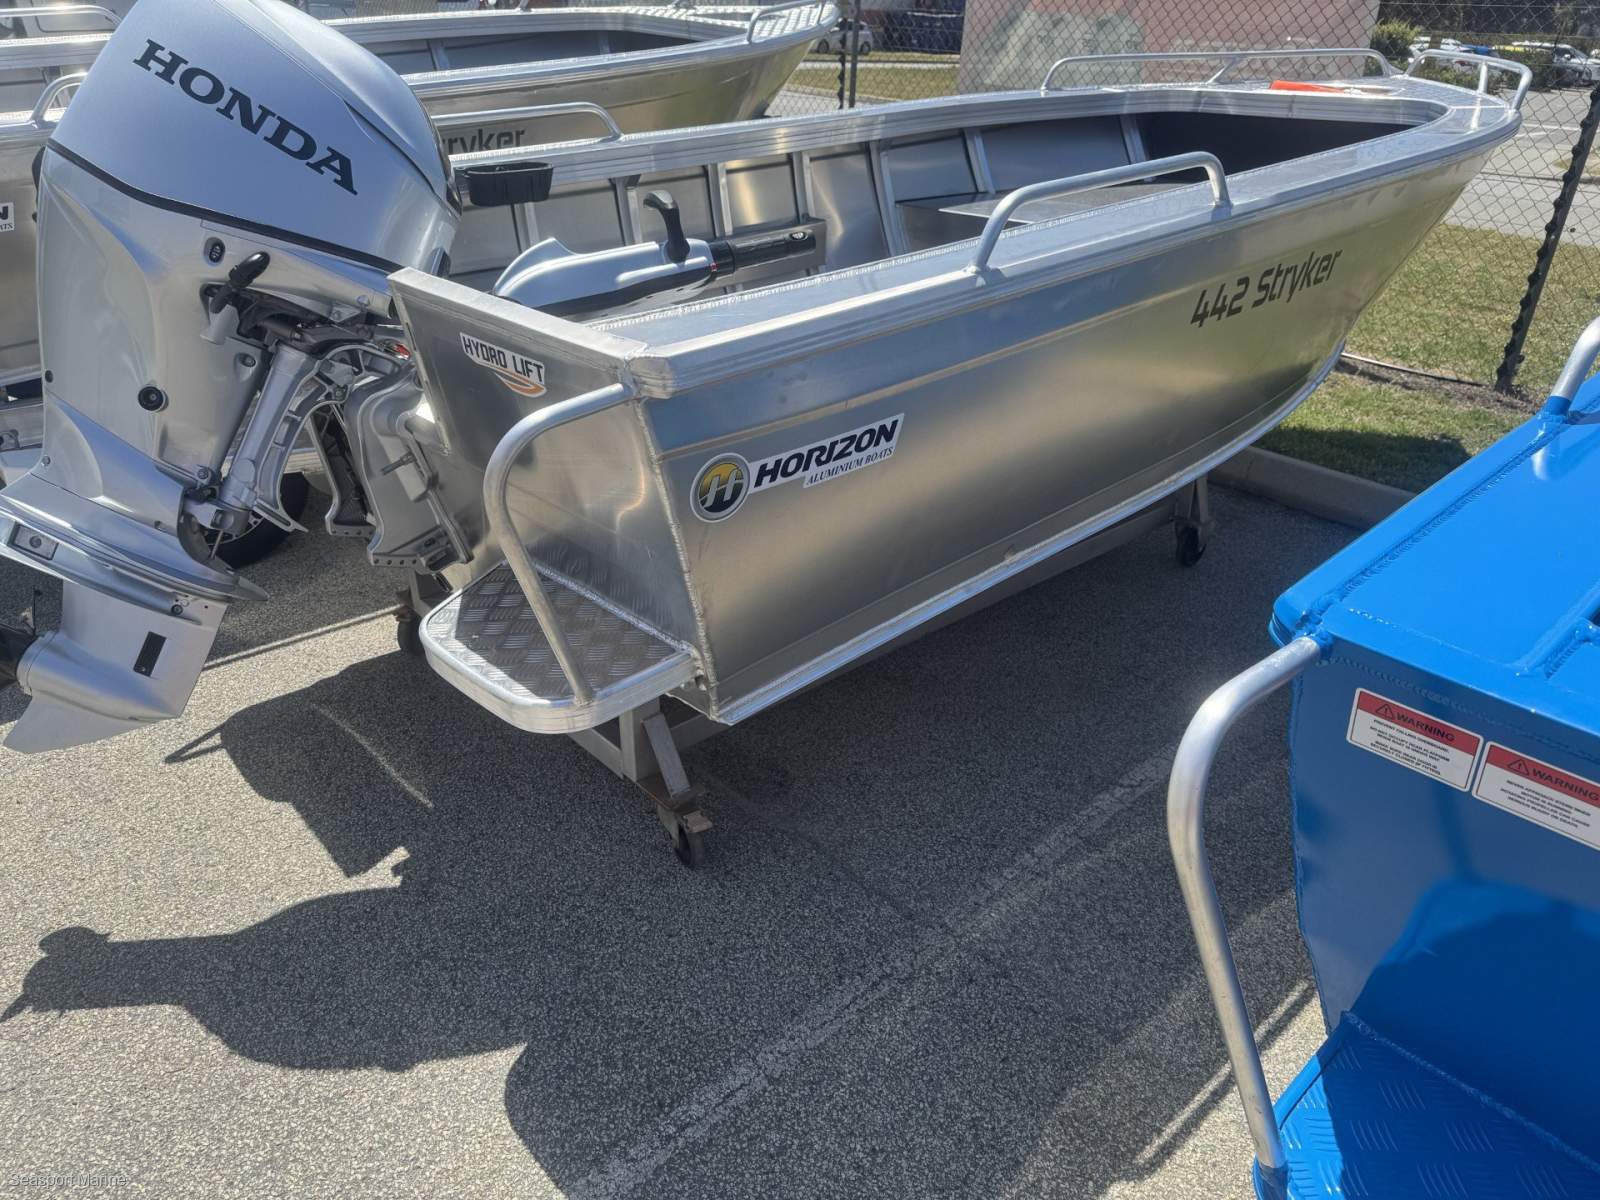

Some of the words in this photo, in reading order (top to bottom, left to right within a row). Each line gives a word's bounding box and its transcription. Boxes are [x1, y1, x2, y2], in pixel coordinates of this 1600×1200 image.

[132, 38, 358, 196] HONDA
[441, 128, 526, 156] ryker
[1190, 276, 1250, 328] 442
[1251, 250, 1343, 309] Stryker
[462, 337, 508, 369] HYDRO
[512, 355, 544, 382] LIFT
[753, 419, 899, 488] HORIZON
[805, 457, 864, 485] ALUMINIUM
[864, 446, 894, 465] BOATS
[1396, 712, 1456, 742] WARNING
[1532, 768, 1600, 801] WARNING
